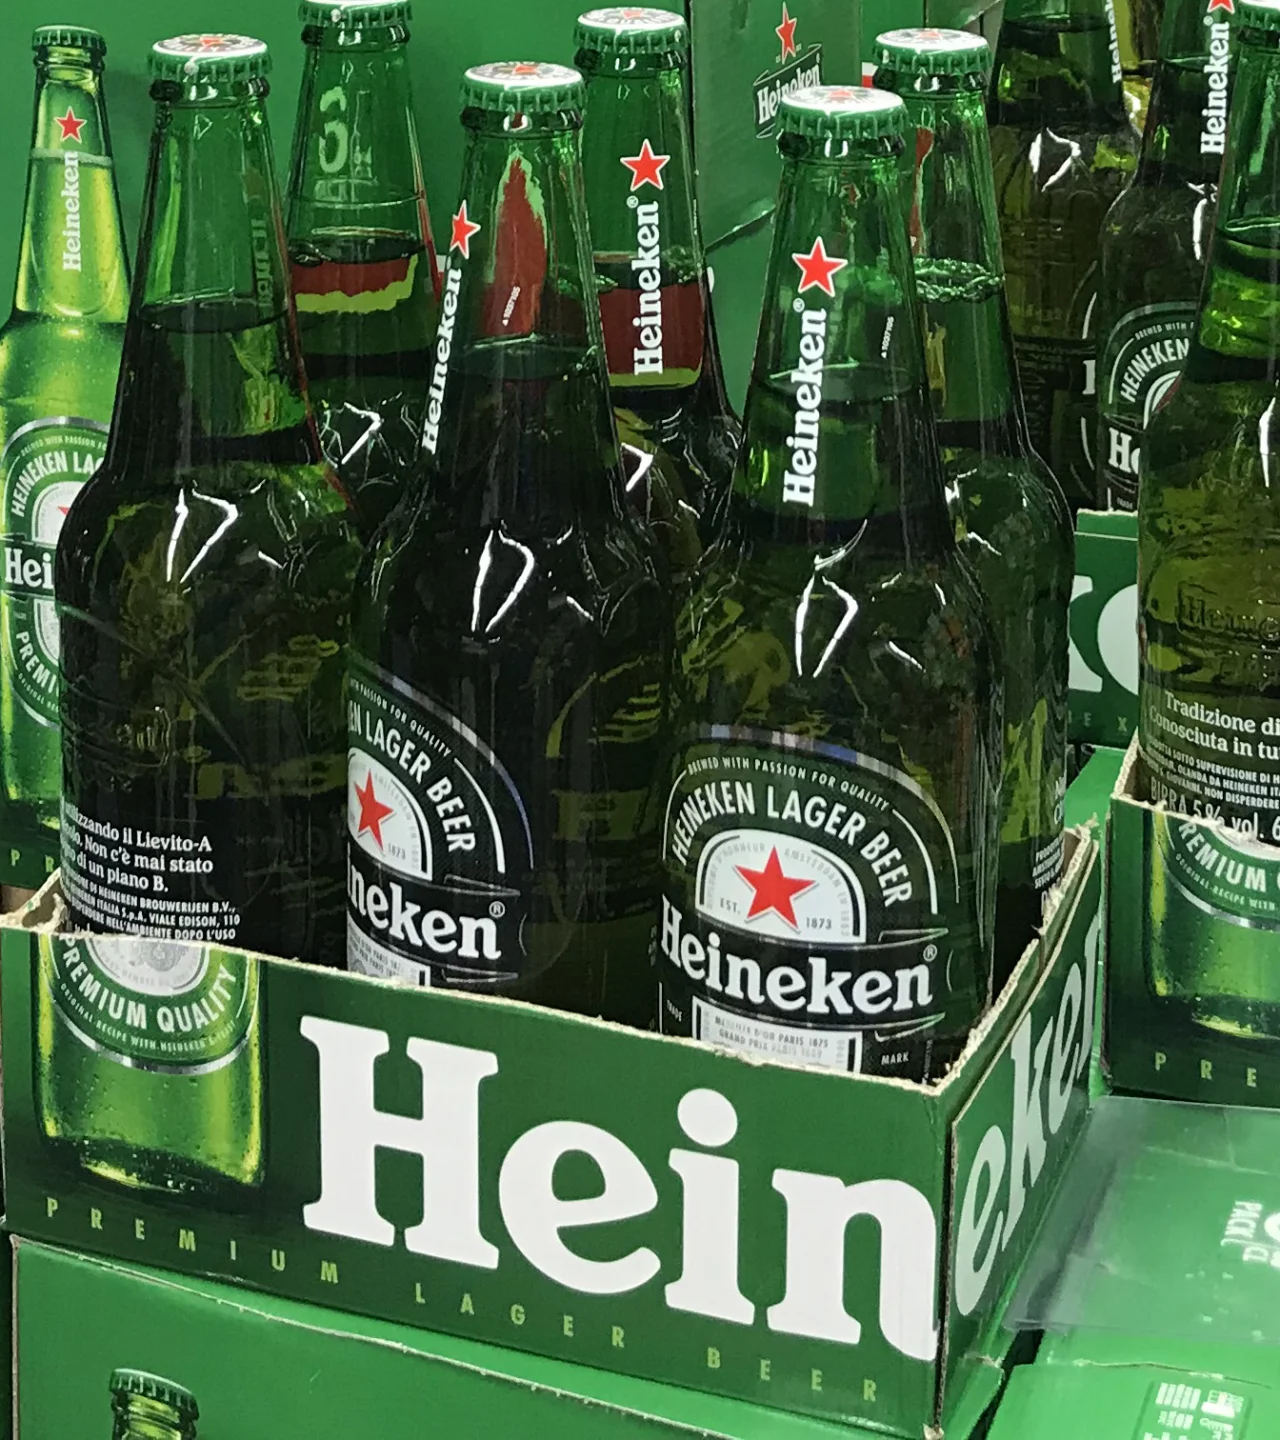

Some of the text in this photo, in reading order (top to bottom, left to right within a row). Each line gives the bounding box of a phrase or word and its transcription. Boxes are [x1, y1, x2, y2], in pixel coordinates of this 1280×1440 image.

[1200, 22, 1229, 156] Heineken
[62, 150, 82, 271] Heineken
[634, 200, 664, 374] Heineken
[423, 267, 463, 454] Heineken
[1120, 338, 1190, 403] HEINEKEN
[782, 308, 827, 506] Heineken
[10, 451, 67, 518] HEINEKEN
[390, 704, 451, 757] FOR QUALITY
[1149, 705, 1228, 752] Conosciuta
[1233, 737, 1253, 757] in
[1164, 690, 1256, 734] Tradizione
[1261, 717, 1280, 736] di
[365, 710, 476, 853] LAGER BEER
[723, 757, 889, 811] WITH PASSION FOR QUALITY
[1177, 764, 1207, 783] OLANDA
[1209, 776, 1221, 787] DA
[1223, 779, 1268, 797] HEINEKEN
[1196, 756, 1257, 782] SUPERVISIONE
[1260, 772, 1271, 783] DI
[1204, 786, 1223, 800] NON
[1225, 792, 1280, 810] DISPERDERE
[123, 827, 212, 852] il Lievito-A
[672, 780, 913, 907] HEINEKEN LAGER BEER
[1231, 812, 1265, 838] vol.
[77, 852, 169, 893] di un piano B.
[85, 834, 213, 873] Non c'è mai stato
[97, 899, 241, 927] ITALIA VIALE EDISON, 110
[98, 884, 209, 913] HEINEKEN BROUWERIJEN
[805, 917, 833, 930] 1873
[174, 928, 236, 940] DOPO L'USO
[661, 894, 933, 1014] Heineken
[60, 937, 236, 1033] PREMIUM QUALITY
[881, 1052, 909, 1065] MARK
